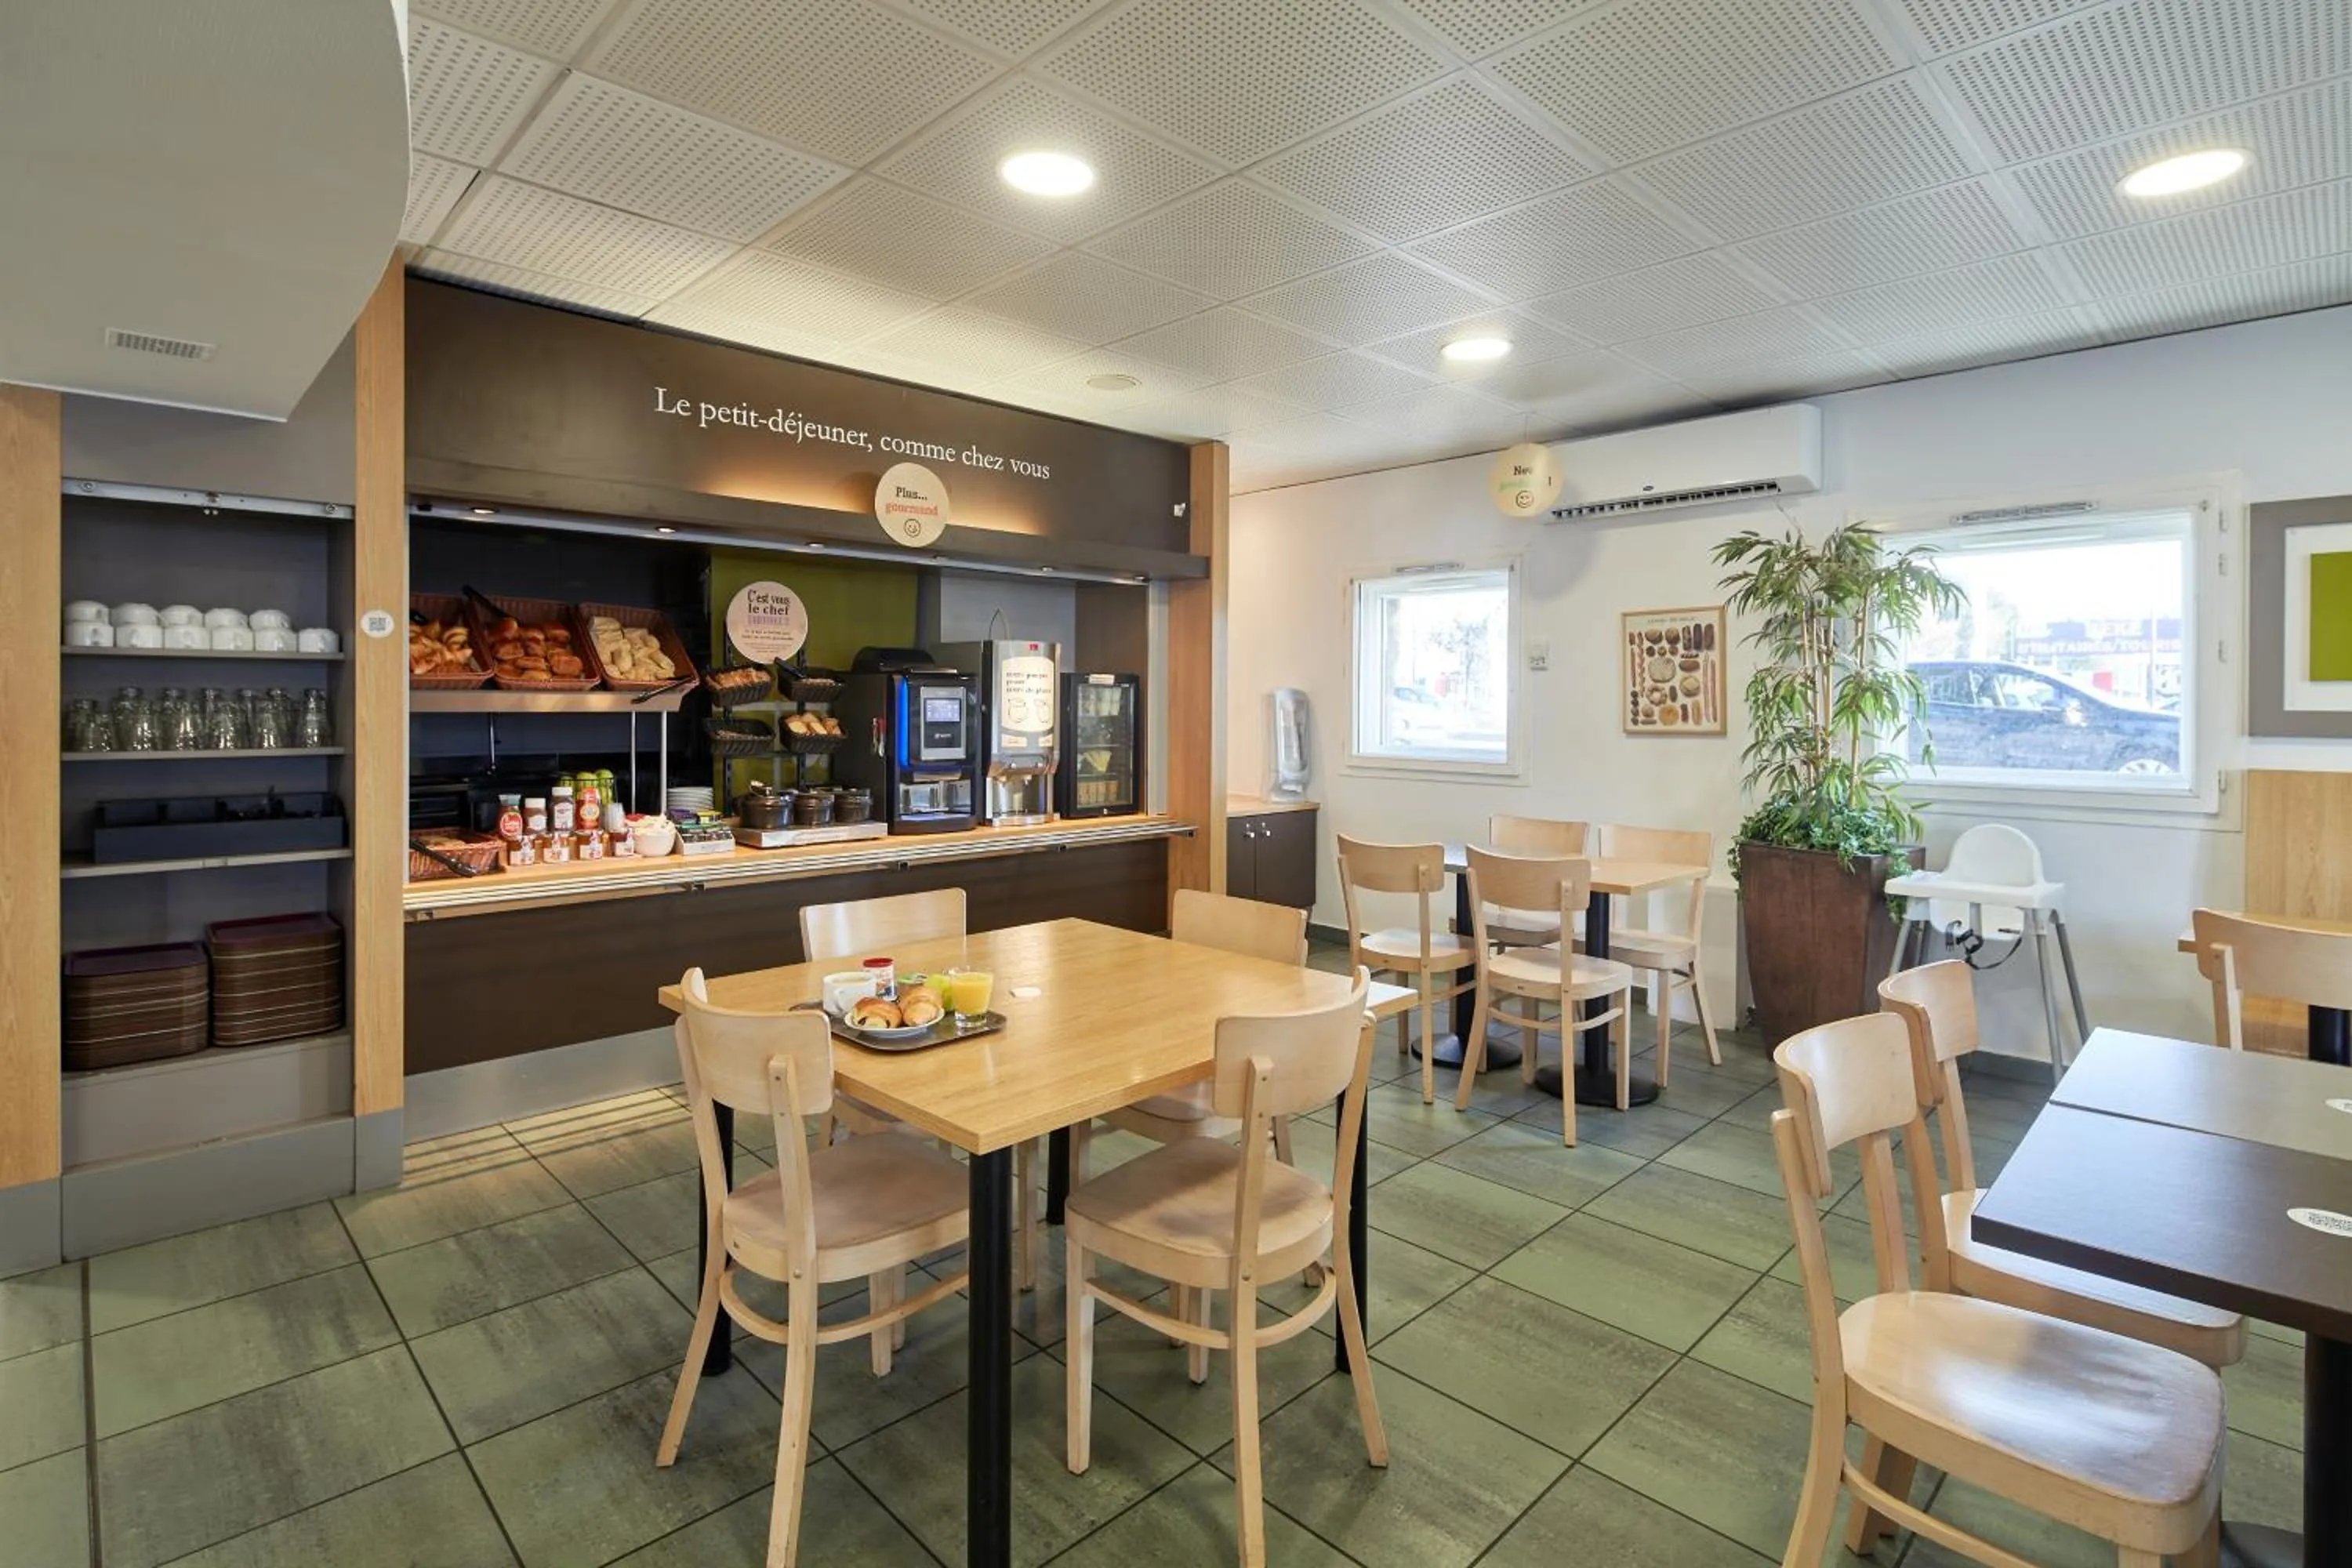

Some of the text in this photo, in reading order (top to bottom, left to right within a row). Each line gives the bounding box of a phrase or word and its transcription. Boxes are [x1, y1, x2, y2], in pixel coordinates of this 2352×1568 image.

[655, 387, 1051, 480] Le petit-déjeuner, comme chez vous
[748, 603, 760, 615] le
